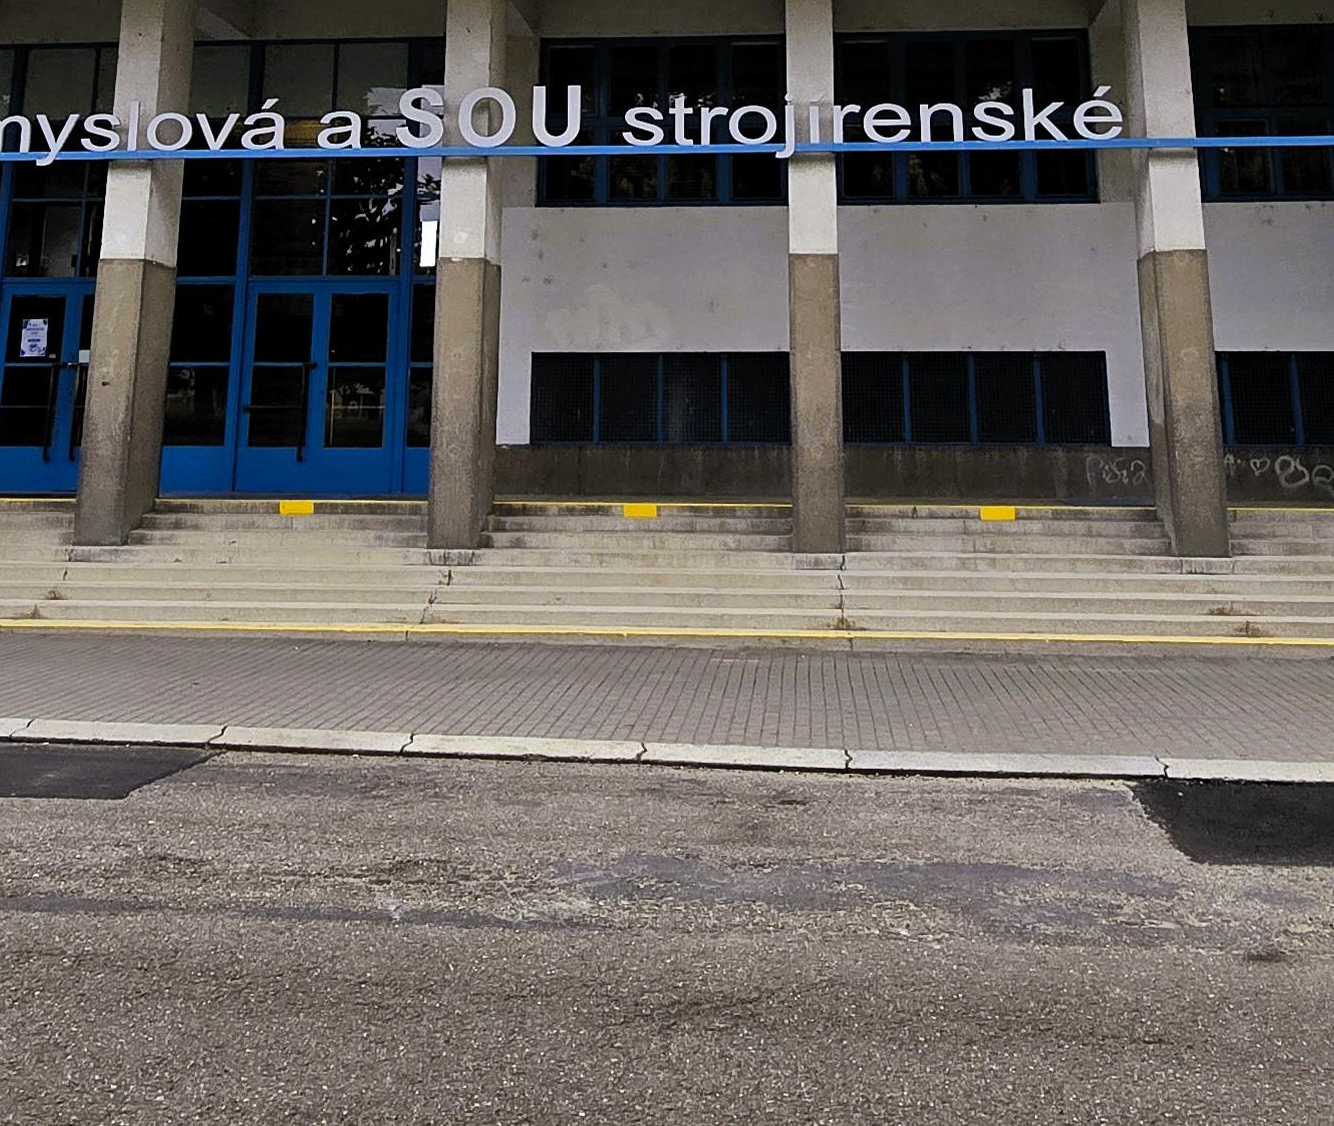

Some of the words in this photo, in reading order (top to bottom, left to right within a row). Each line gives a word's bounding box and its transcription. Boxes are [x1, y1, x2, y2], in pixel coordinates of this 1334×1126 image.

[316, 110, 363, 150] a
[396, 84, 583, 150] SOU
[623, 85, 1123, 160] strojírenské
